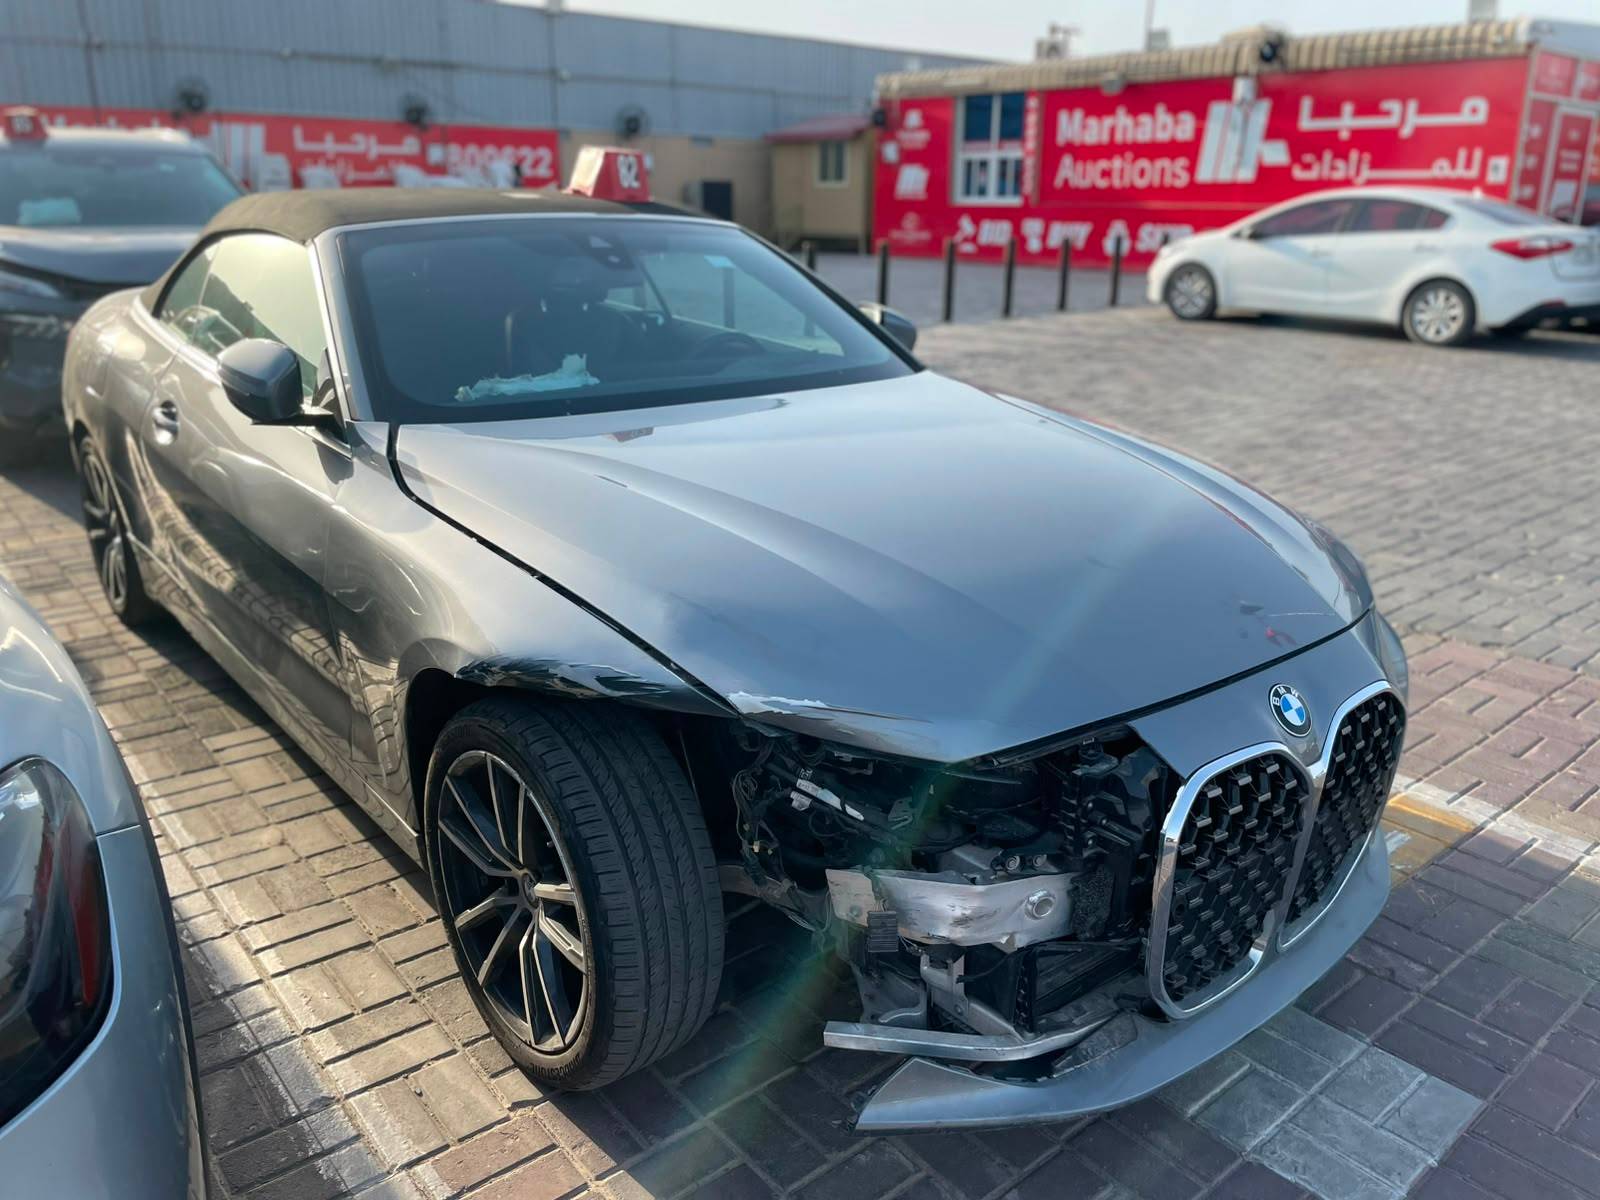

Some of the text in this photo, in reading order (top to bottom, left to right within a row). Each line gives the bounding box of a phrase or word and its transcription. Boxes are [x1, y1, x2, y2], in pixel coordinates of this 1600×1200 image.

[1056, 102, 1196, 147] Marhaba
[1298, 96, 1489, 139] مرحبا
[292, 125, 421, 161] مرحبا
[1054, 152, 1190, 189] Auctions
[1292, 147, 1483, 186] للمزادات
[1273, 686, 1298, 705] BMW
